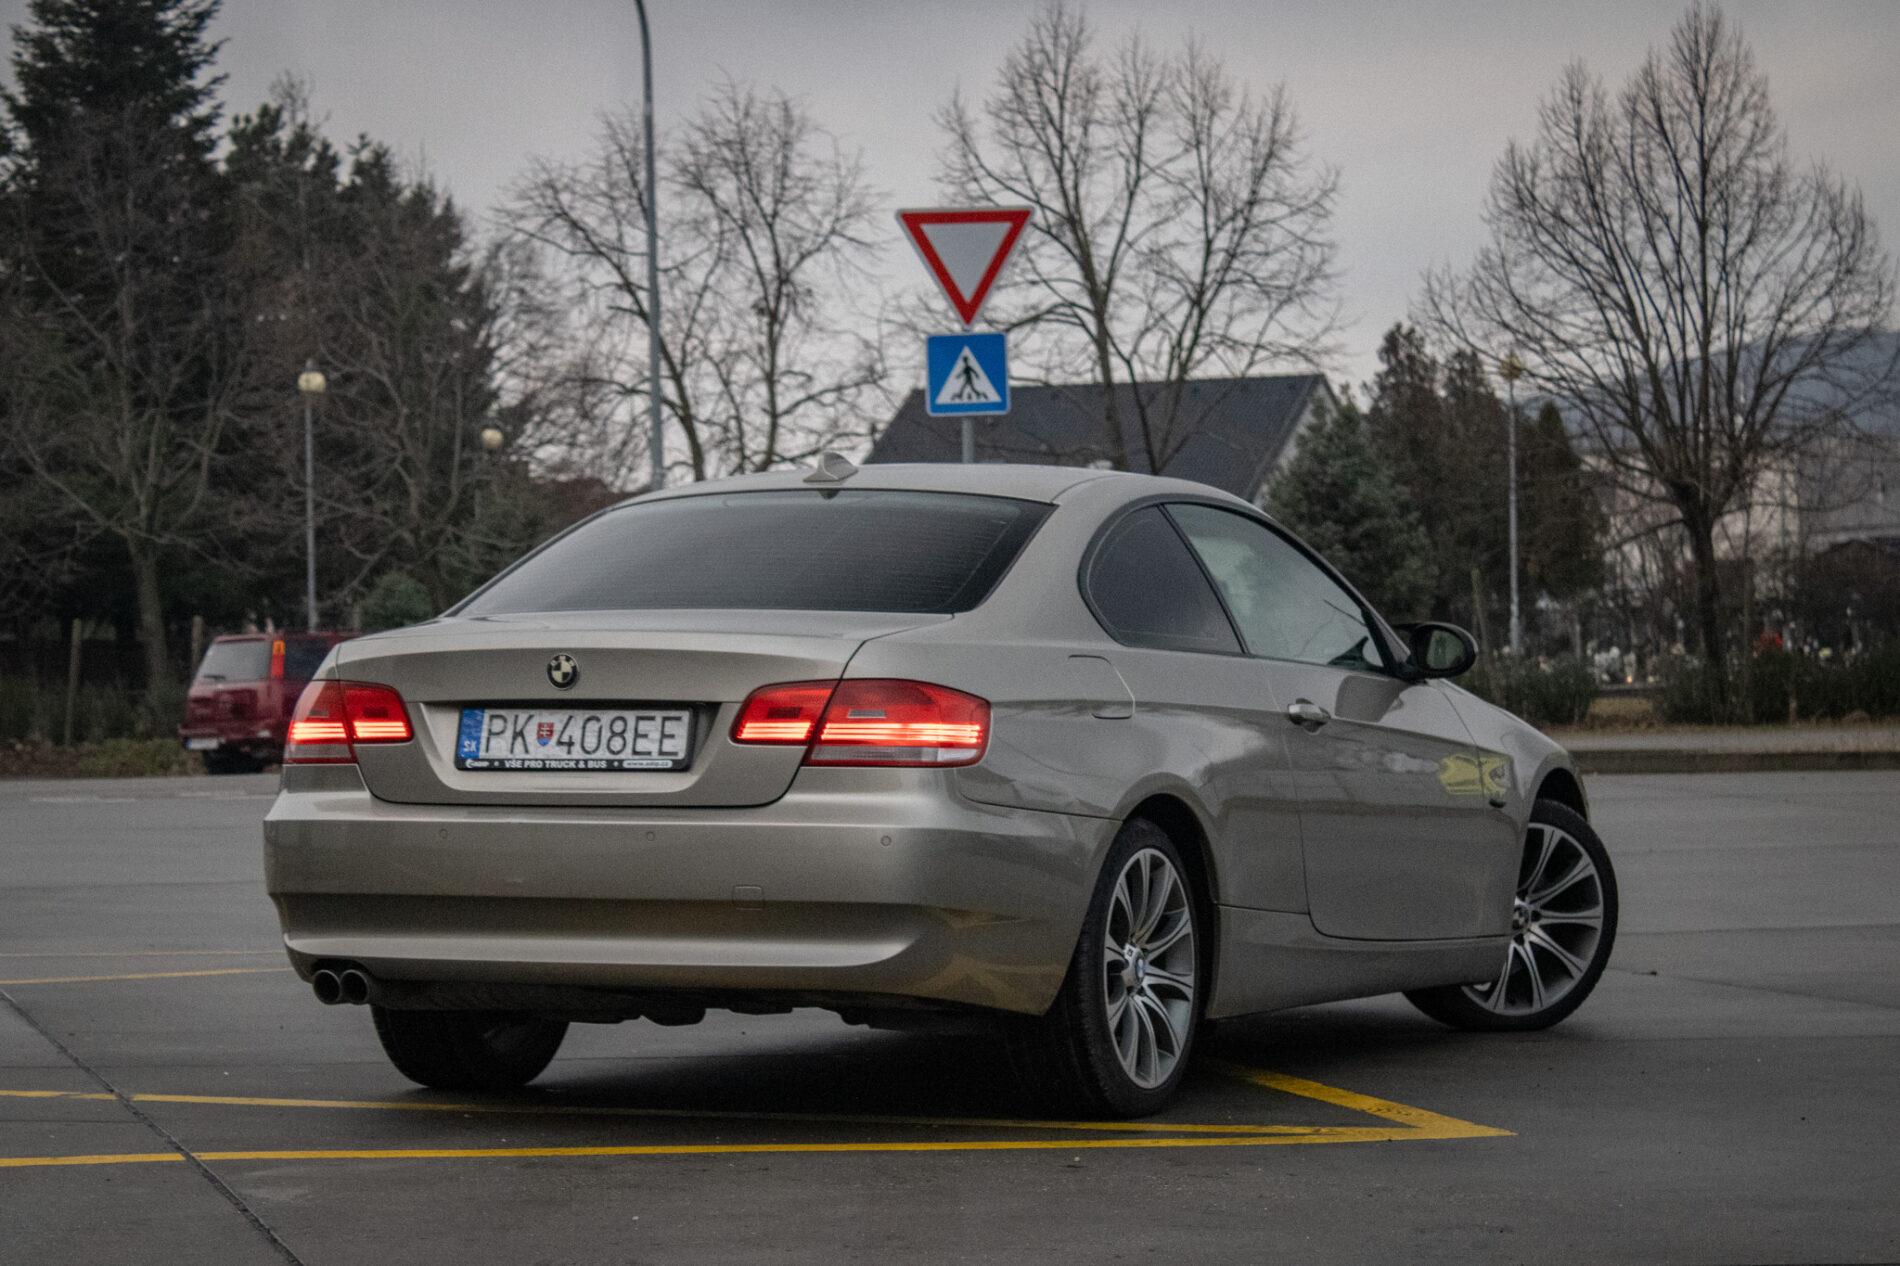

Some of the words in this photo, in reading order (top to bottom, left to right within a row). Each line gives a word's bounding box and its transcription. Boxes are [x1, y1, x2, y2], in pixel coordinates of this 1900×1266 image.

[485, 714, 535, 755] PK
[556, 715, 683, 757] 408EE
[523, 759, 543, 768] PRO
[544, 759, 576, 768] TRUCK
[577, 759, 586, 768] &
[587, 759, 607, 768] BUS
